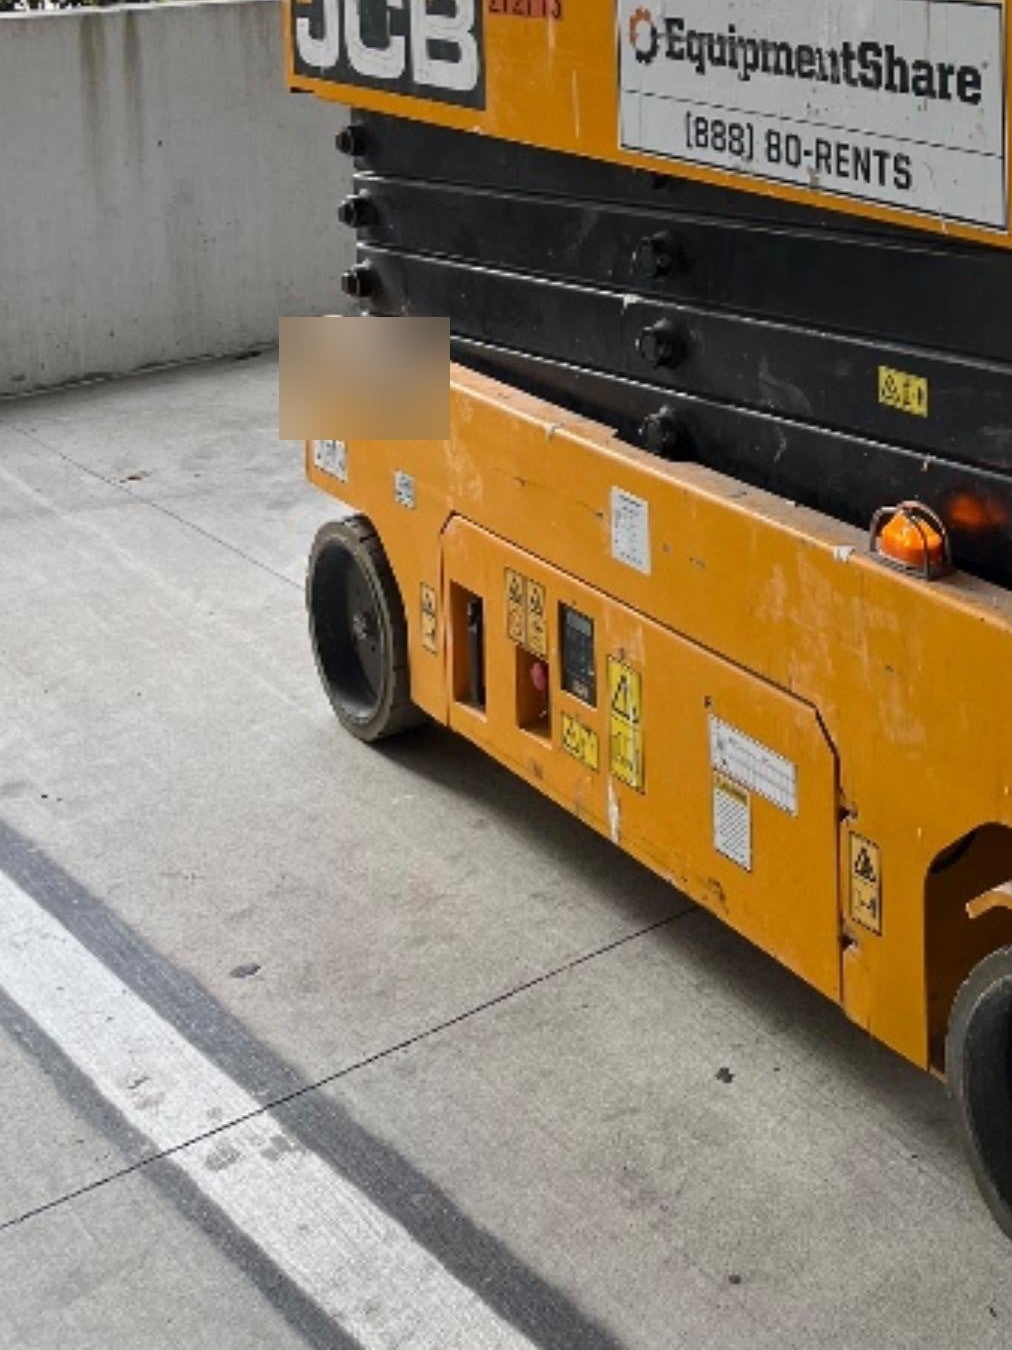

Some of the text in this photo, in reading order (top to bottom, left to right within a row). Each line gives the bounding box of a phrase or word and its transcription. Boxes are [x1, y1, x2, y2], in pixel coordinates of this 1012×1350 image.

[664, 16, 983, 105] EquipmentShare
[685, 110, 913, 191] (888) 80-RENTS
